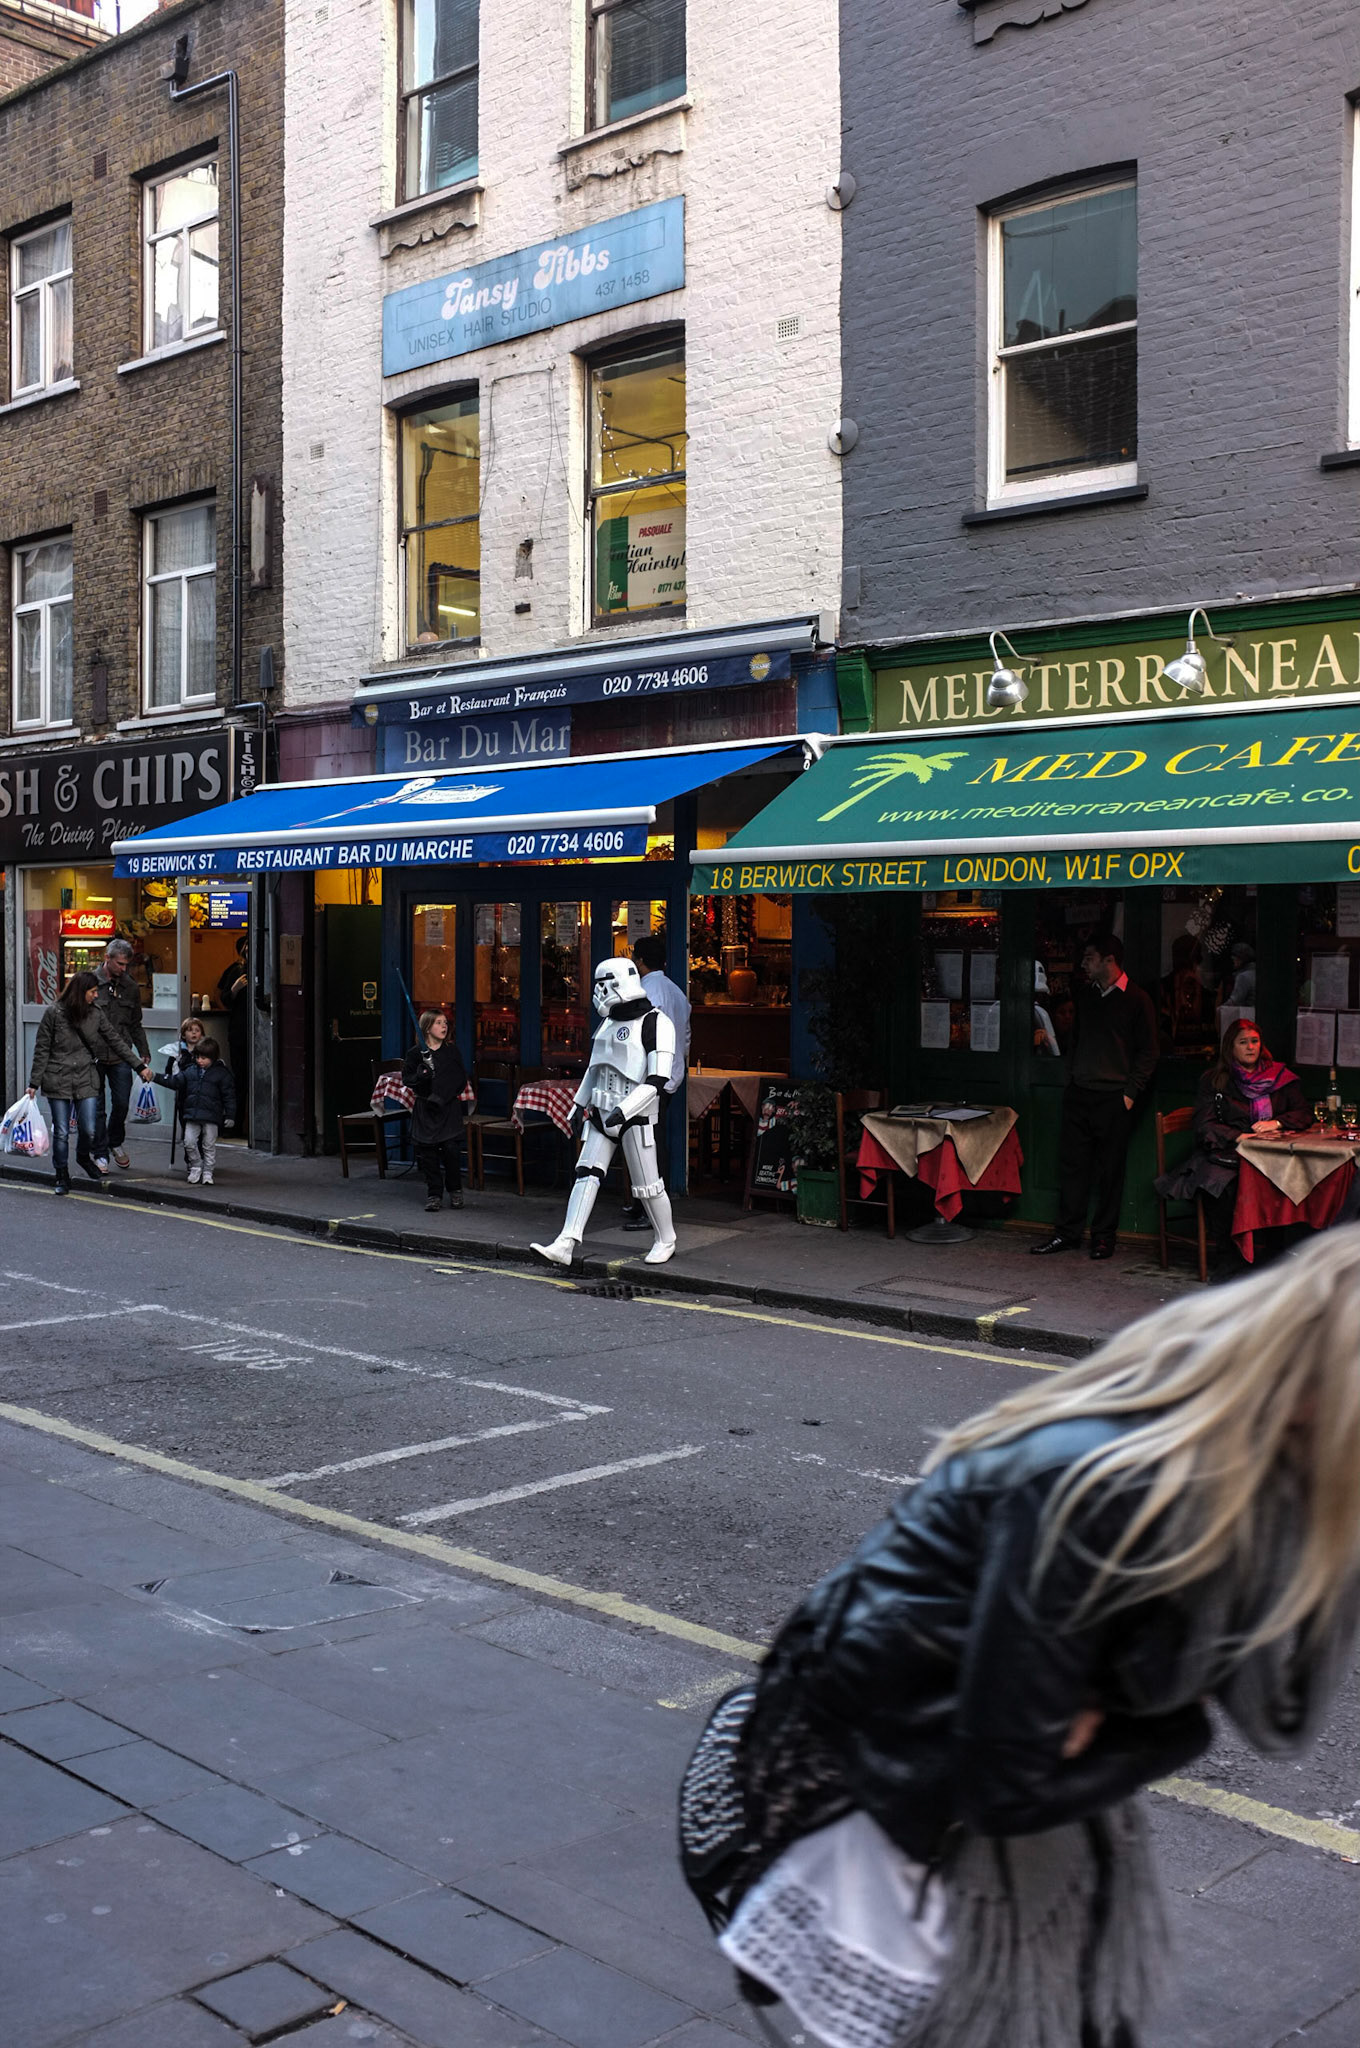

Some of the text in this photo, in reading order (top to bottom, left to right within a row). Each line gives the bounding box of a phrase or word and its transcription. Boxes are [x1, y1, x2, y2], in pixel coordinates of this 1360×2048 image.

[441, 243, 610, 320] Tansy Tibbs
[595, 269, 650, 297] 437 1458
[408, 298, 551, 355] UNISEX HAIR STUDIO
[639, 523, 673, 538] PASQUALE
[409, 665, 709, 719] Bar et Restaurant Français 020 7734 4606
[404, 718, 571, 764] Bar Du Mar
[54, 764, 80, 813] &
[93, 748, 222, 809] CHIPS
[966, 749, 1148, 785] MED
[22, 822, 45, 847] The
[50, 821, 95, 850] Dining
[128, 831, 624, 873] 19 BERWICK ST. RESTAURANT BAR DU MARCHE 020 7734 4606
[710, 867, 732, 889] 18
[739, 863, 836, 889] BERWICK
[841, 860, 927, 887] STREET,
[943, 856, 1052, 884] LONDON,
[1064, 853, 1121, 880] W1F
